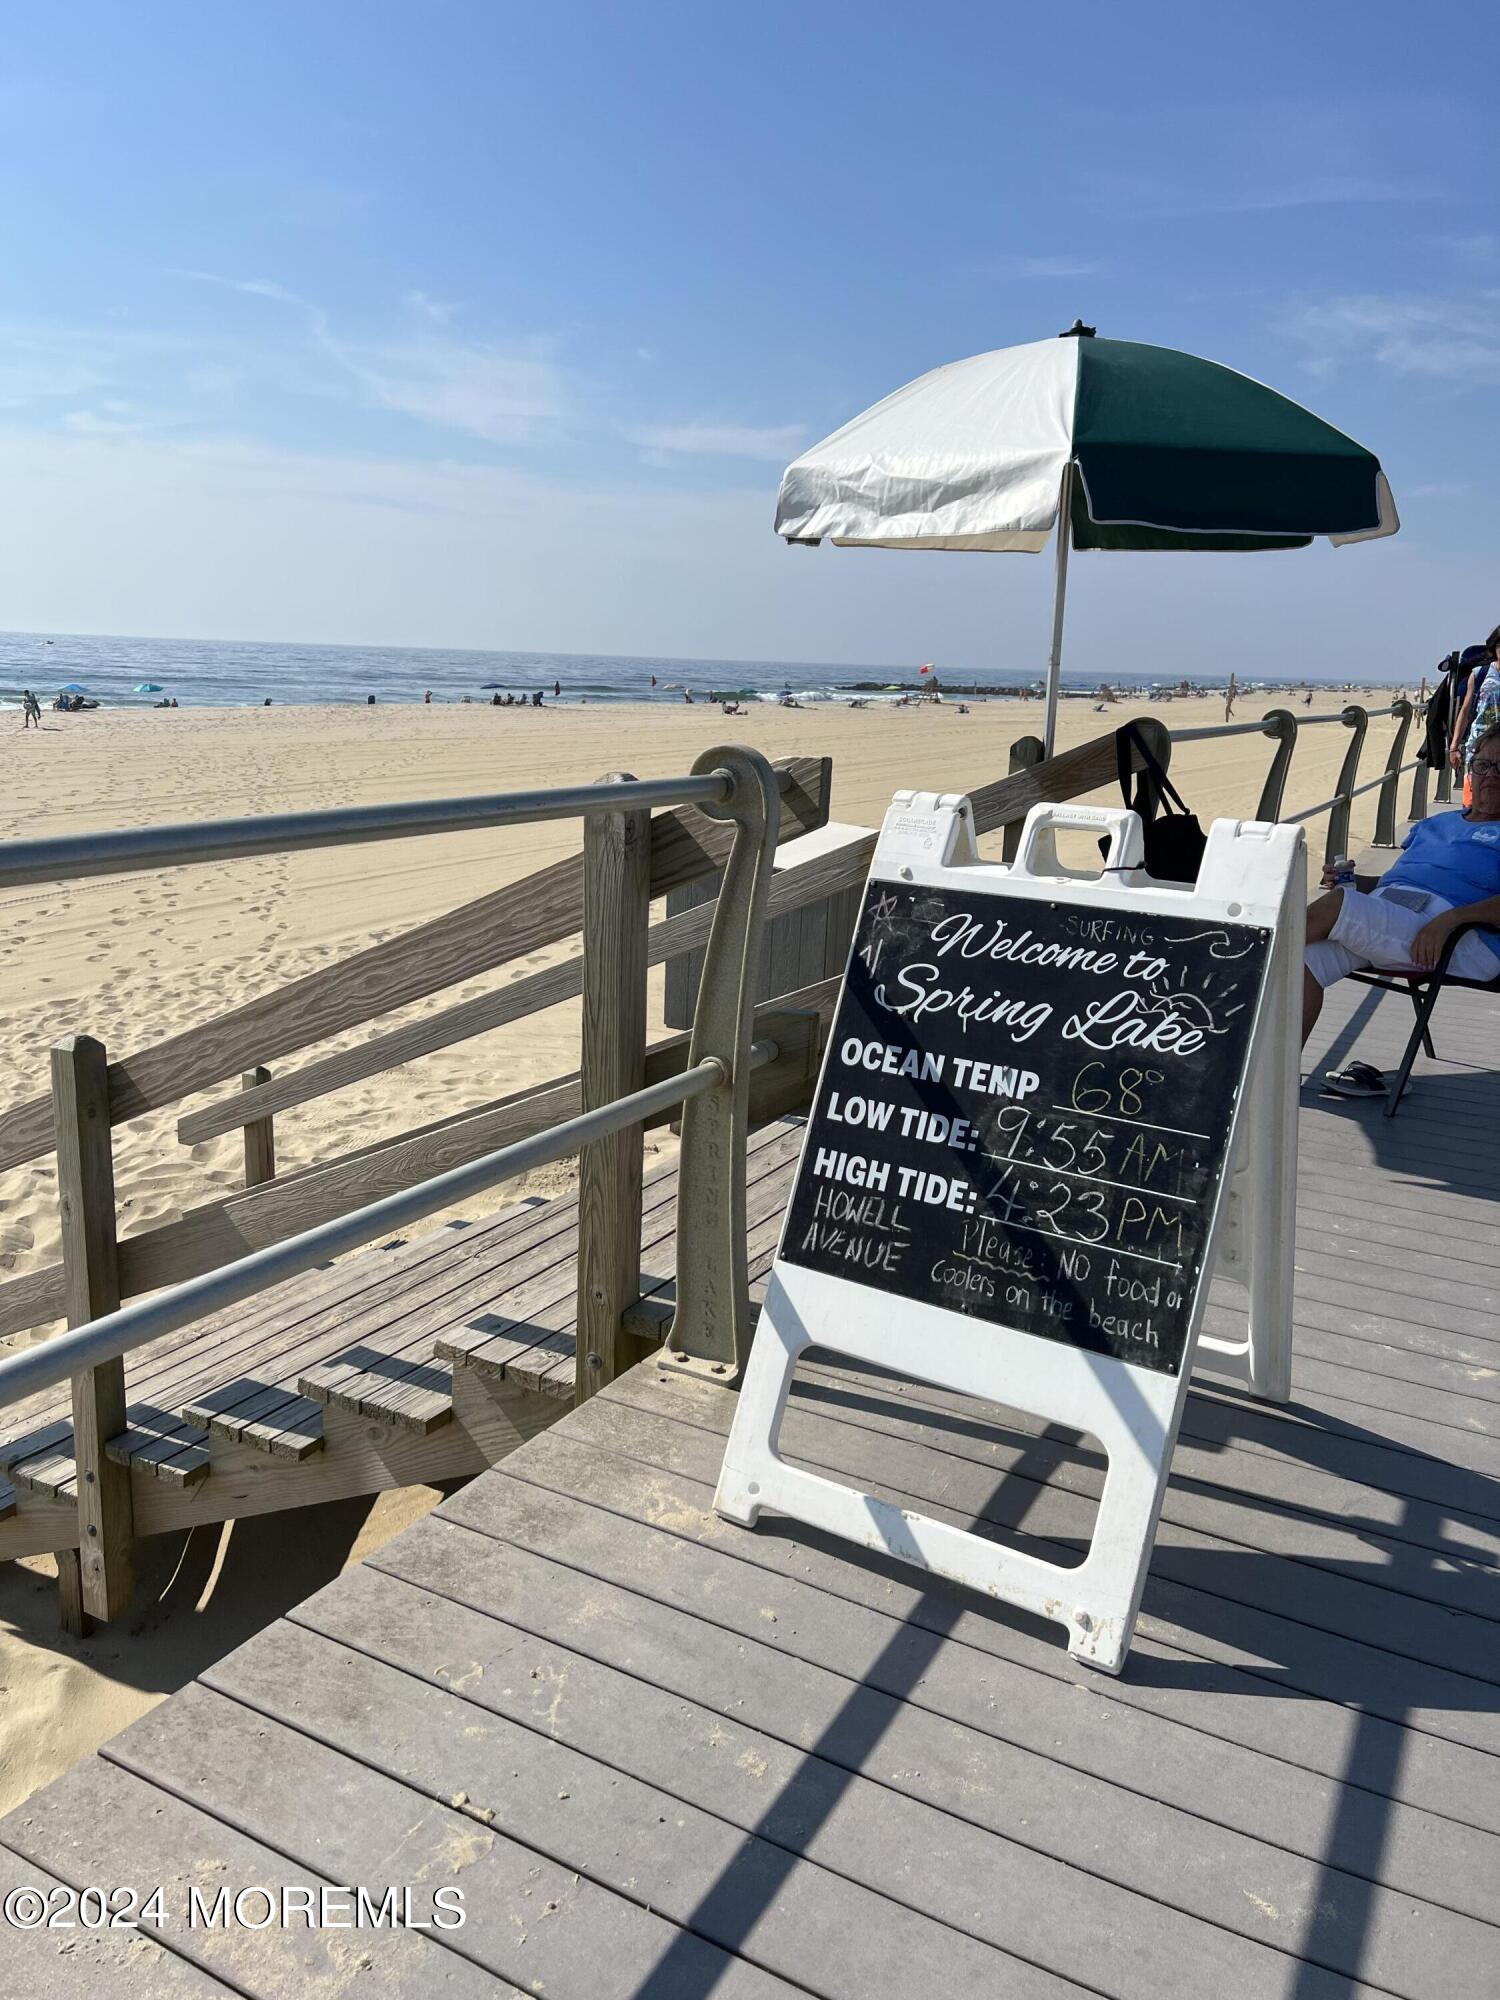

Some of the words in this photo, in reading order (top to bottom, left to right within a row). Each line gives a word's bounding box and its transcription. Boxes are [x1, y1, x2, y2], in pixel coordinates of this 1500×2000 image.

[930, 913, 1119, 975] Welcome
[1122, 951, 1171, 981] to
[1064, 915, 1154, 946] SURFING
[874, 963, 1053, 1043] Spring
[1061, 990, 1206, 1056] Lake
[841, 1037, 946, 1083] OCEAN
[952, 1057, 1040, 1100] TEMP
[826, 1091, 896, 1132] LOW
[900, 1106, 980, 1151] TIDE:
[997, 1105, 1116, 1175] 9:55
[813, 1147, 891, 1192] HIGH
[897, 1166, 978, 1214] TIDE:
[813, 1184, 912, 1232] HOWELL
[985, 1163, 1110, 1243] 4:23
[1116, 1197, 1184, 1257] PM
[801, 1221, 911, 1272] AVENUE
[1103, 1258, 1161, 1308] food
[1166, 1289, 1184, 1310] or
[1005, 1285, 1030, 1309] on
[1040, 1289, 1073, 1321] the
[1089, 1297, 1159, 1348] beach
